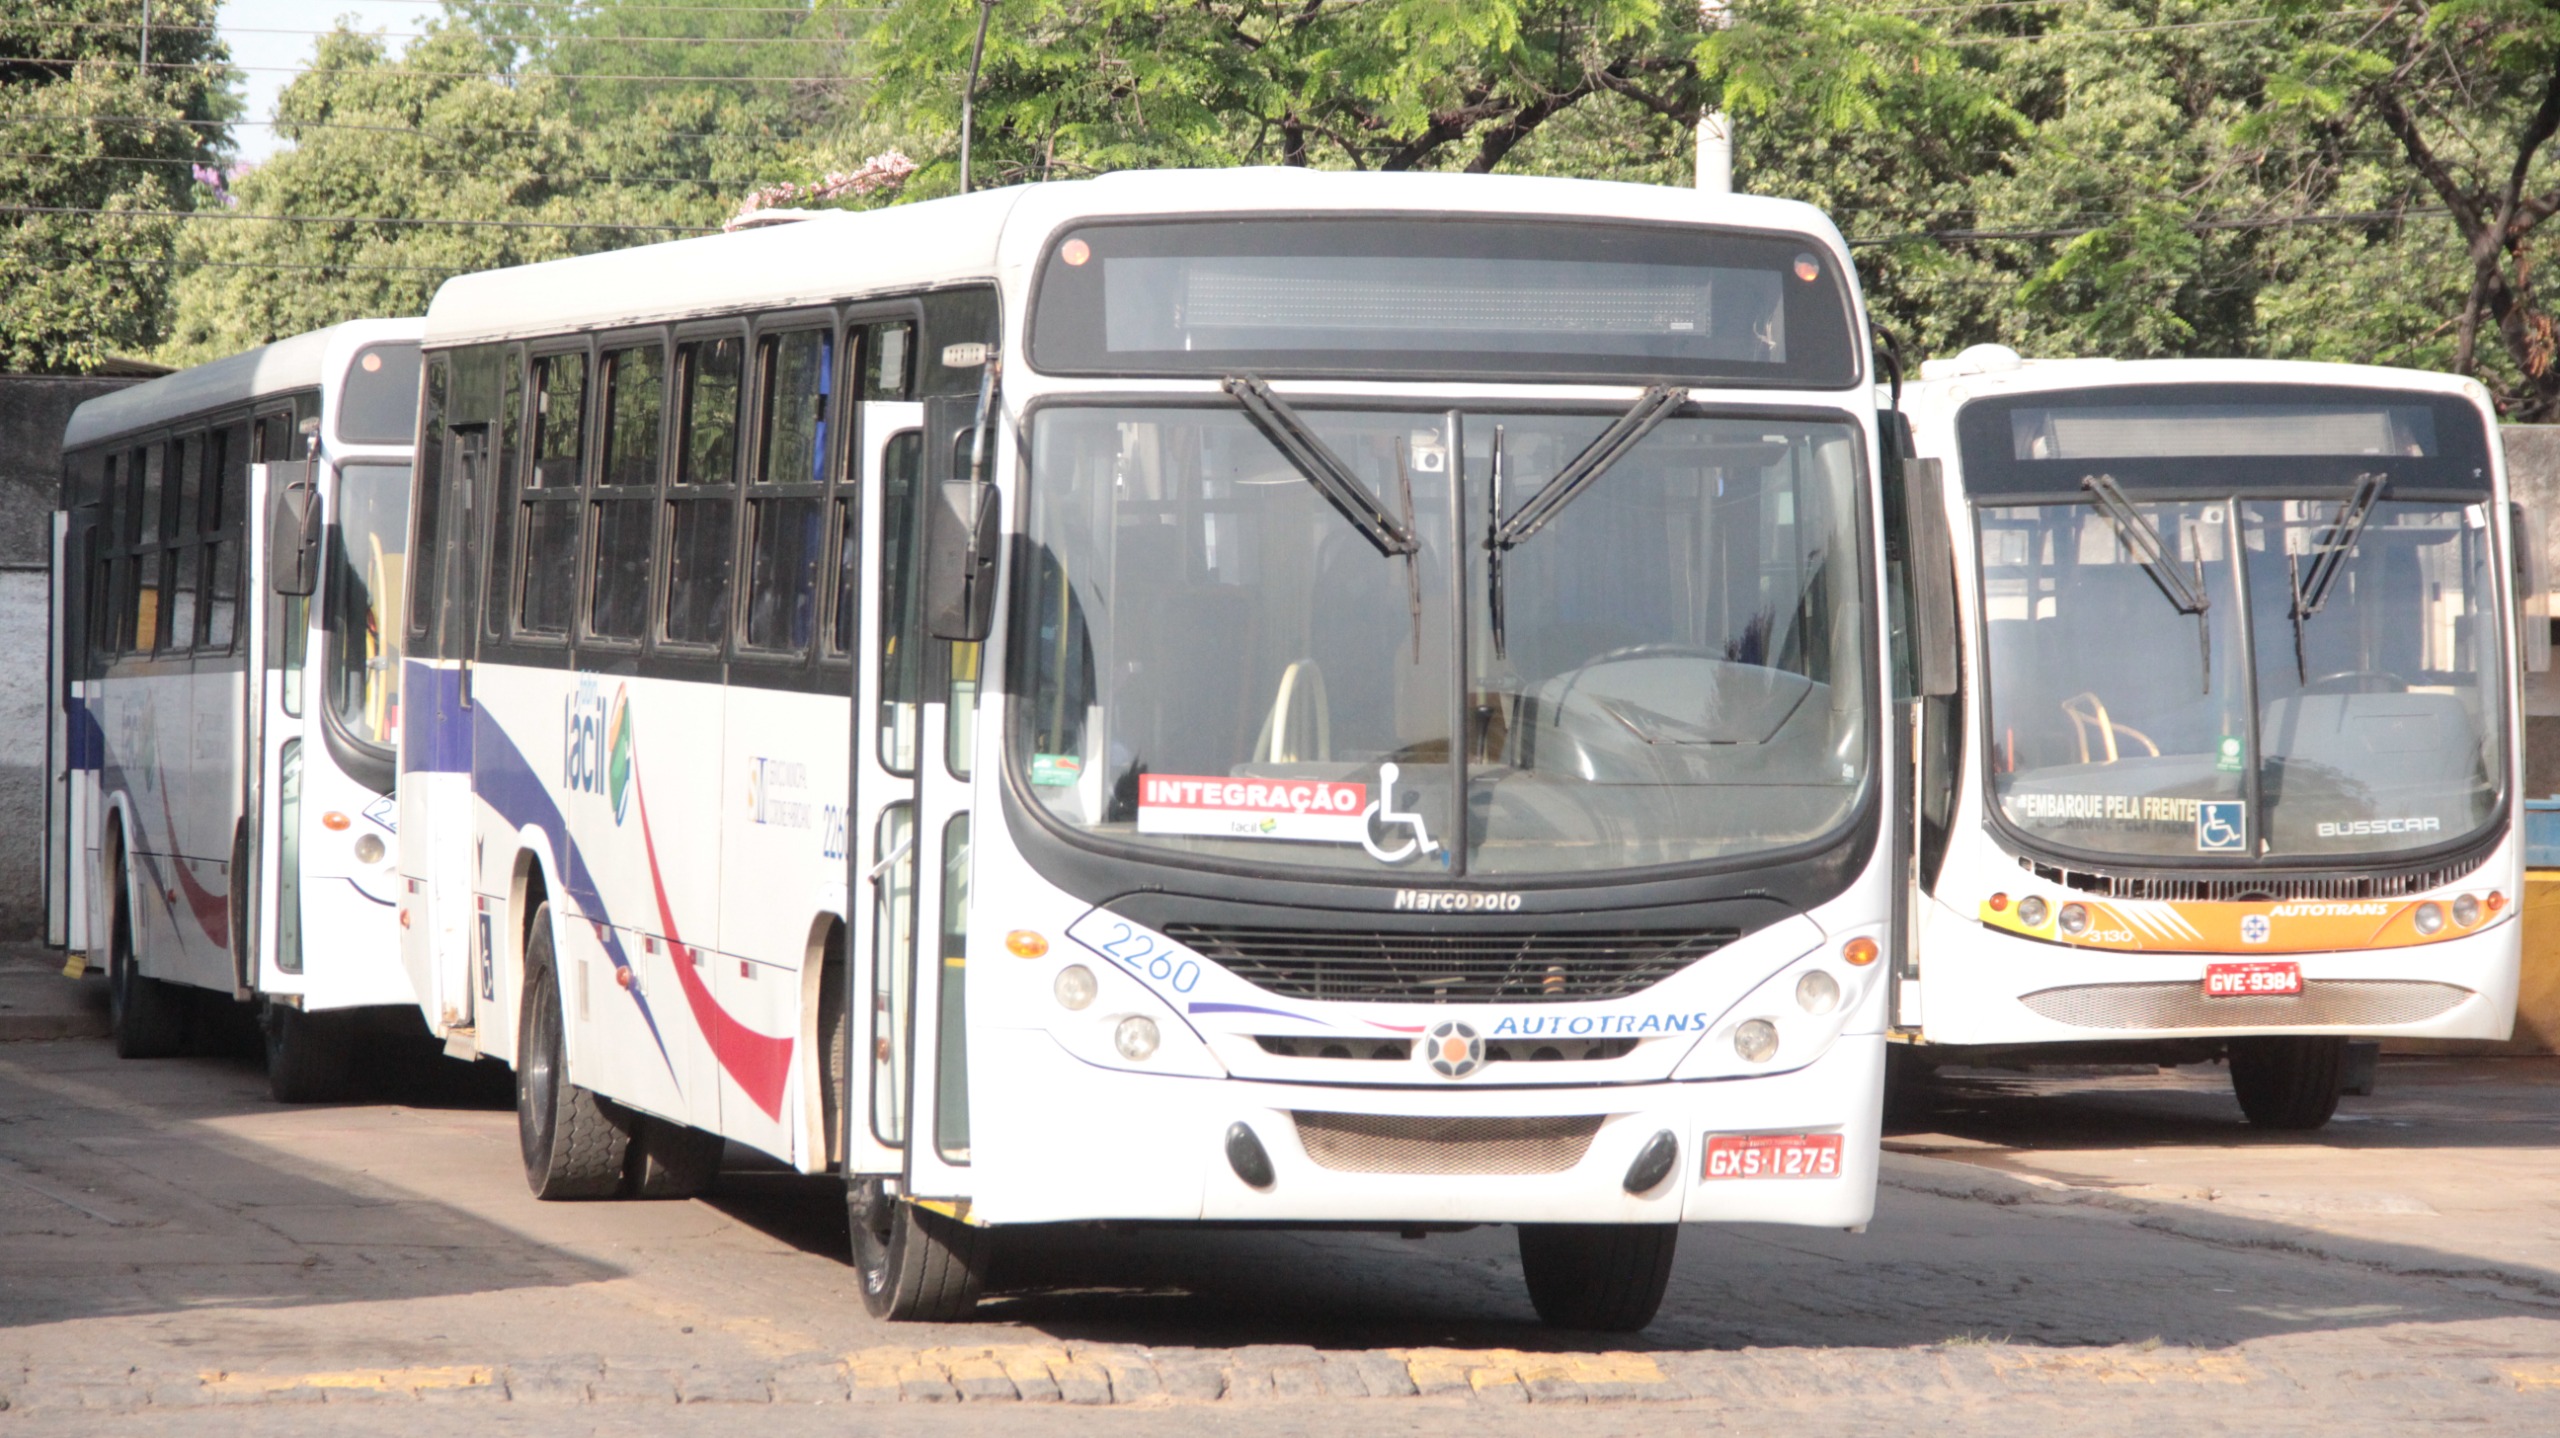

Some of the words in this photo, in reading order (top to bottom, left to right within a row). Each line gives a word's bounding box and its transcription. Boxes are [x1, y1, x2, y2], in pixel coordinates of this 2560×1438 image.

[1147, 780, 1357, 813] INTEGRAÇÃO
[2106, 796, 2140, 820] PELA
[823, 804, 849, 861] 226
[2317, 816, 2440, 837] BUSSCAR
[1394, 889, 1521, 911] Marcopolo
[2269, 902, 2389, 917] AUTOTRANS
[2089, 929, 2133, 943] 3130
[1102, 922, 1201, 993] 2260
[1493, 1013, 1707, 1035] AUTOTRANS
